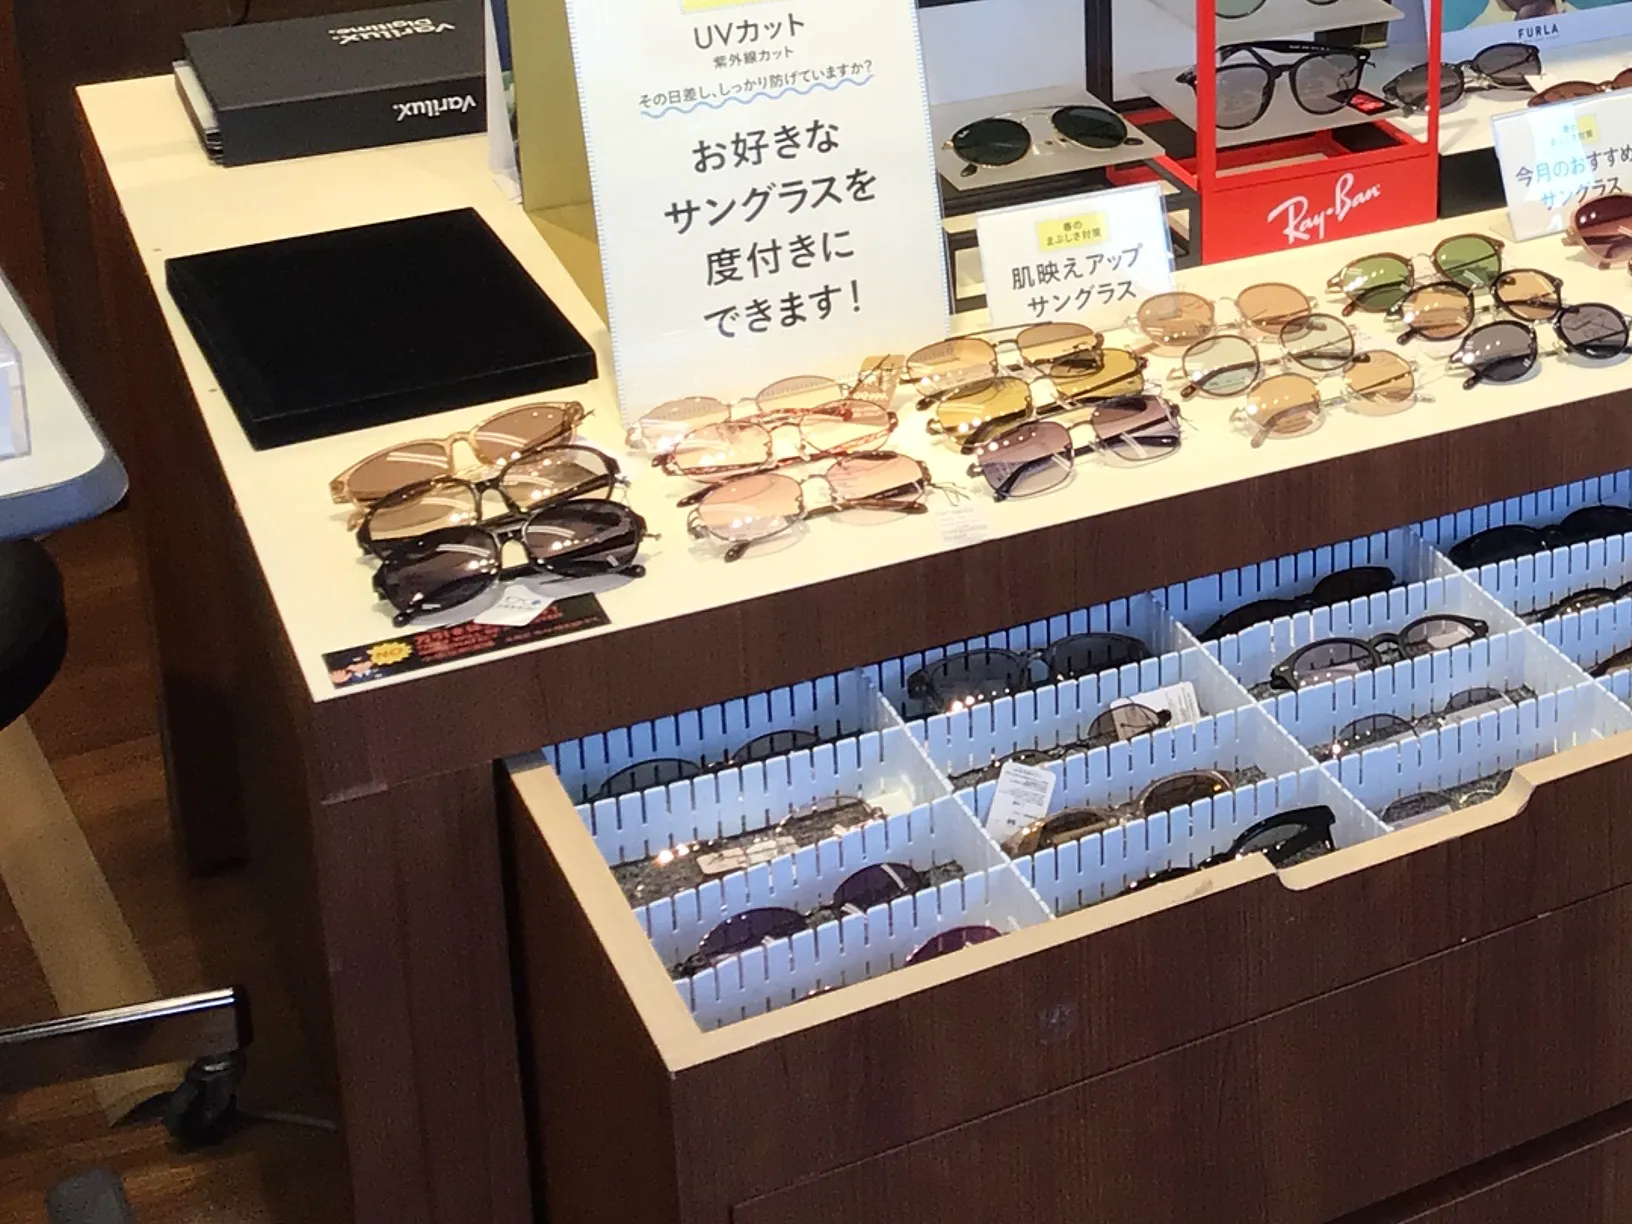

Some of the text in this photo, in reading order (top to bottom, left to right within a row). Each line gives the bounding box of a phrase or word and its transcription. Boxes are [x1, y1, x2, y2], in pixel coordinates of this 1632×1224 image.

[693, 12, 806, 51] UVカット
[1517, 23, 1560, 40] FURLA
[713, 45, 795, 70] 紫外線カット
[692, 119, 840, 174] お好きな
[664, 167, 877, 236] サングラスを
[1267, 172, 1381, 245] Ray-Ban
[1540, 176, 1623, 211] サングラス
[1046, 227, 1102, 247] まぶしさ対策
[1063, 220, 1083, 232] 春の
[706, 228, 855, 287] 度付きに
[1012, 242, 1144, 291] 肌映えアップ
[703, 278, 862, 339] できます！
[1027, 279, 1138, 319] サングラス
[376, 646, 404, 661] NO
